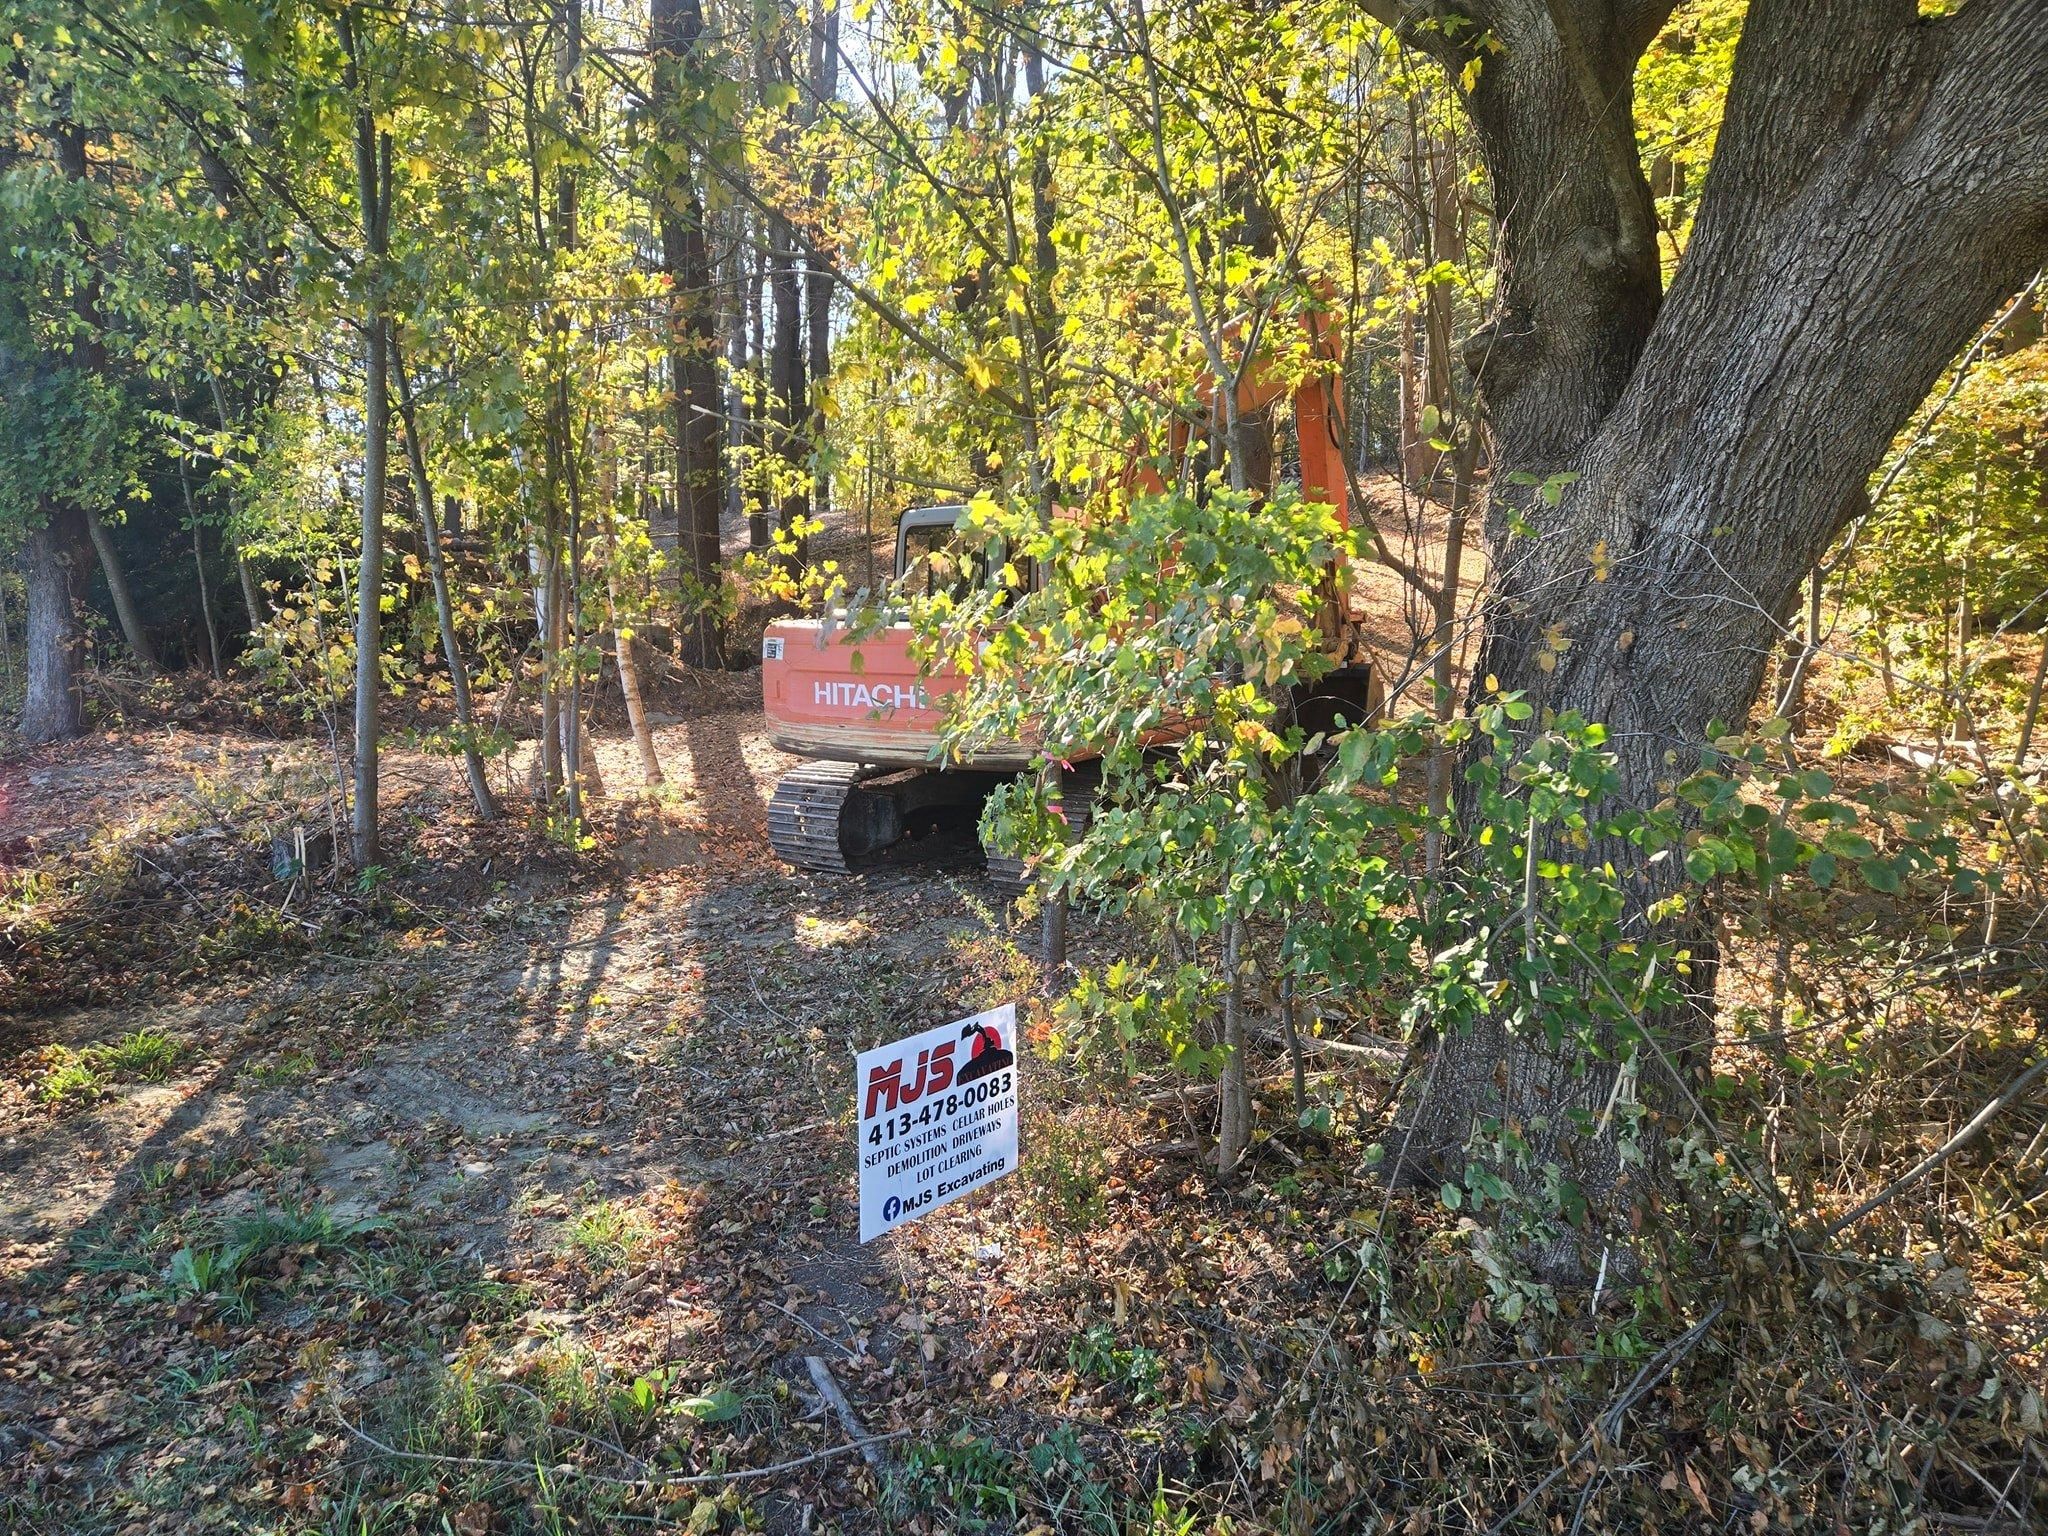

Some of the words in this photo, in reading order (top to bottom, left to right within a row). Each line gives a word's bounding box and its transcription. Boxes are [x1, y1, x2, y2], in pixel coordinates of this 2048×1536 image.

[864, 1040, 956, 1120] MJS
[868, 1072, 1012, 1146] 413-478-0083
[864, 1143, 902, 1169] SEPTIC
[903, 1124, 947, 1152] SYSTEMS
[952, 1110, 986, 1131] CELLAR
[987, 1095, 1015, 1115] HOLES
[887, 1139, 948, 1178] DEMOLITION
[952, 1118, 1002, 1150] DRIVEWAYS
[916, 1165, 936, 1184] LOT
[938, 1144, 982, 1174] CLEARING
[902, 1188, 933, 1214] MJS
[937, 1157, 1005, 1198] Excavating
